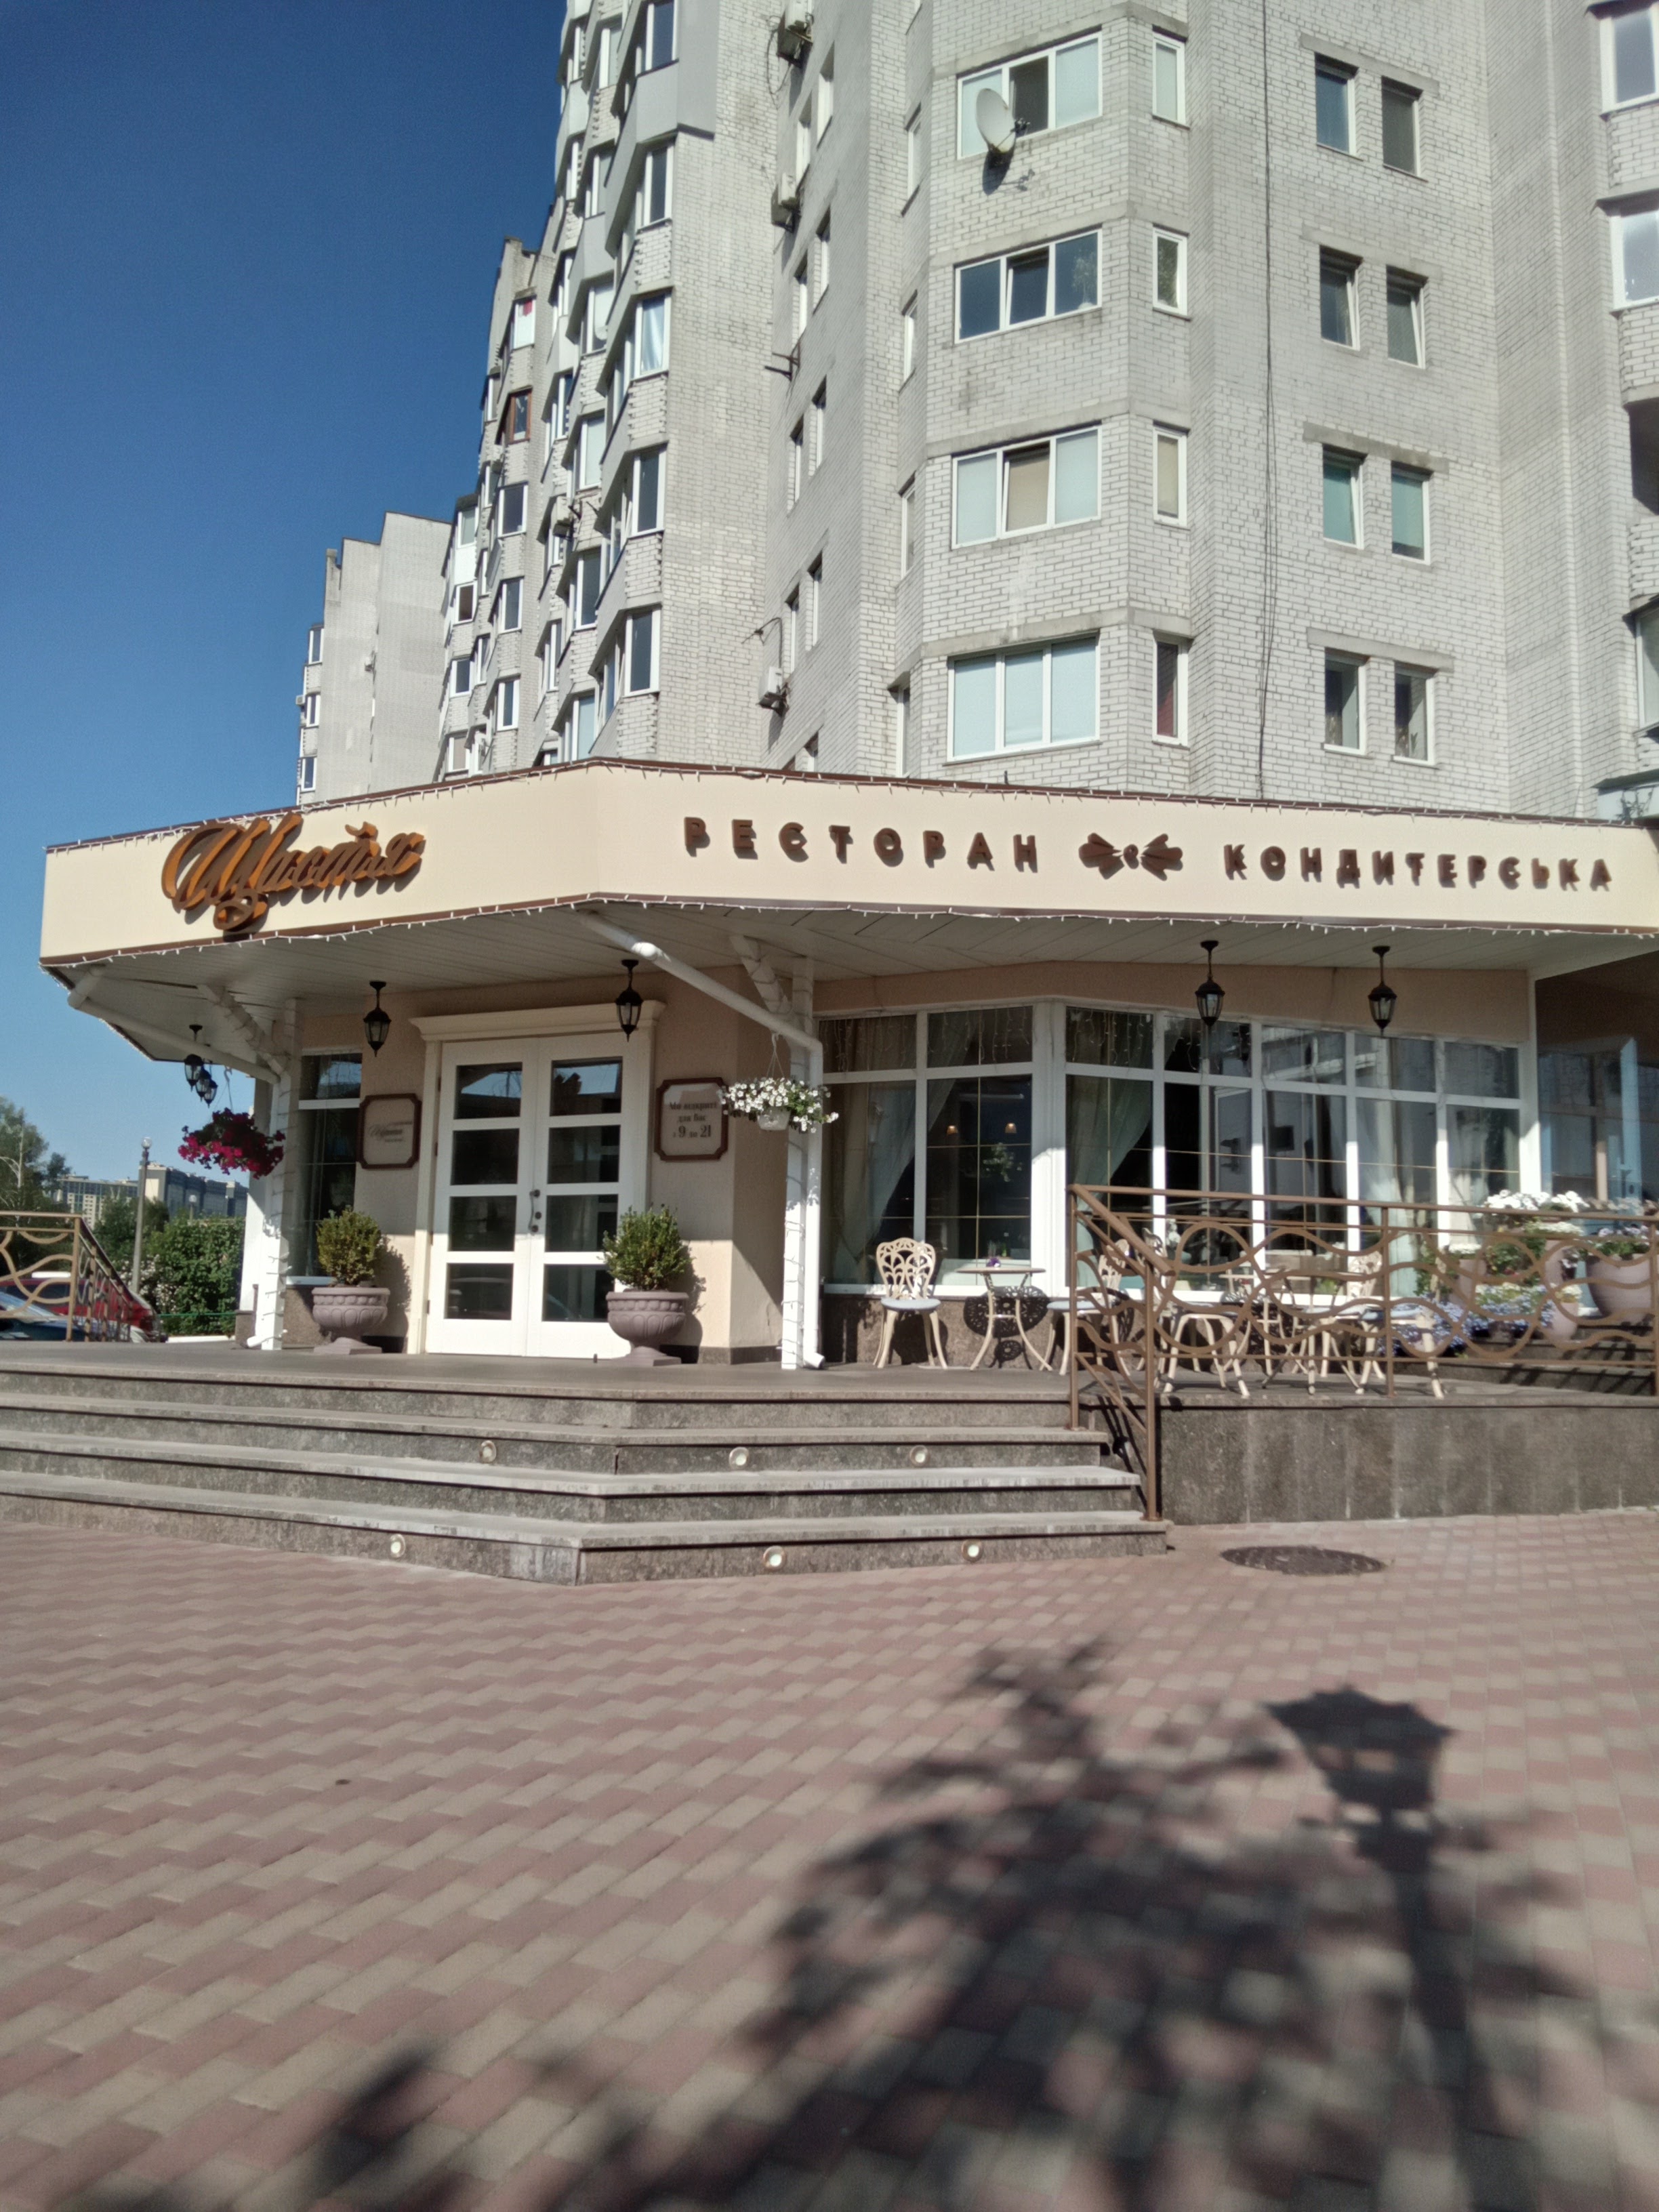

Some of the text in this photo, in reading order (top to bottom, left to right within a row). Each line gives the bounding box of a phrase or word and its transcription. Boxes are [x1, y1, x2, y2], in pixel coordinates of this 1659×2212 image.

[683, 816, 1612, 890] РЕСТОРАН КОНДИТЕРСЬКА
[678, 1125, 686, 1137] 9
[700, 1125, 711, 1137] 21
